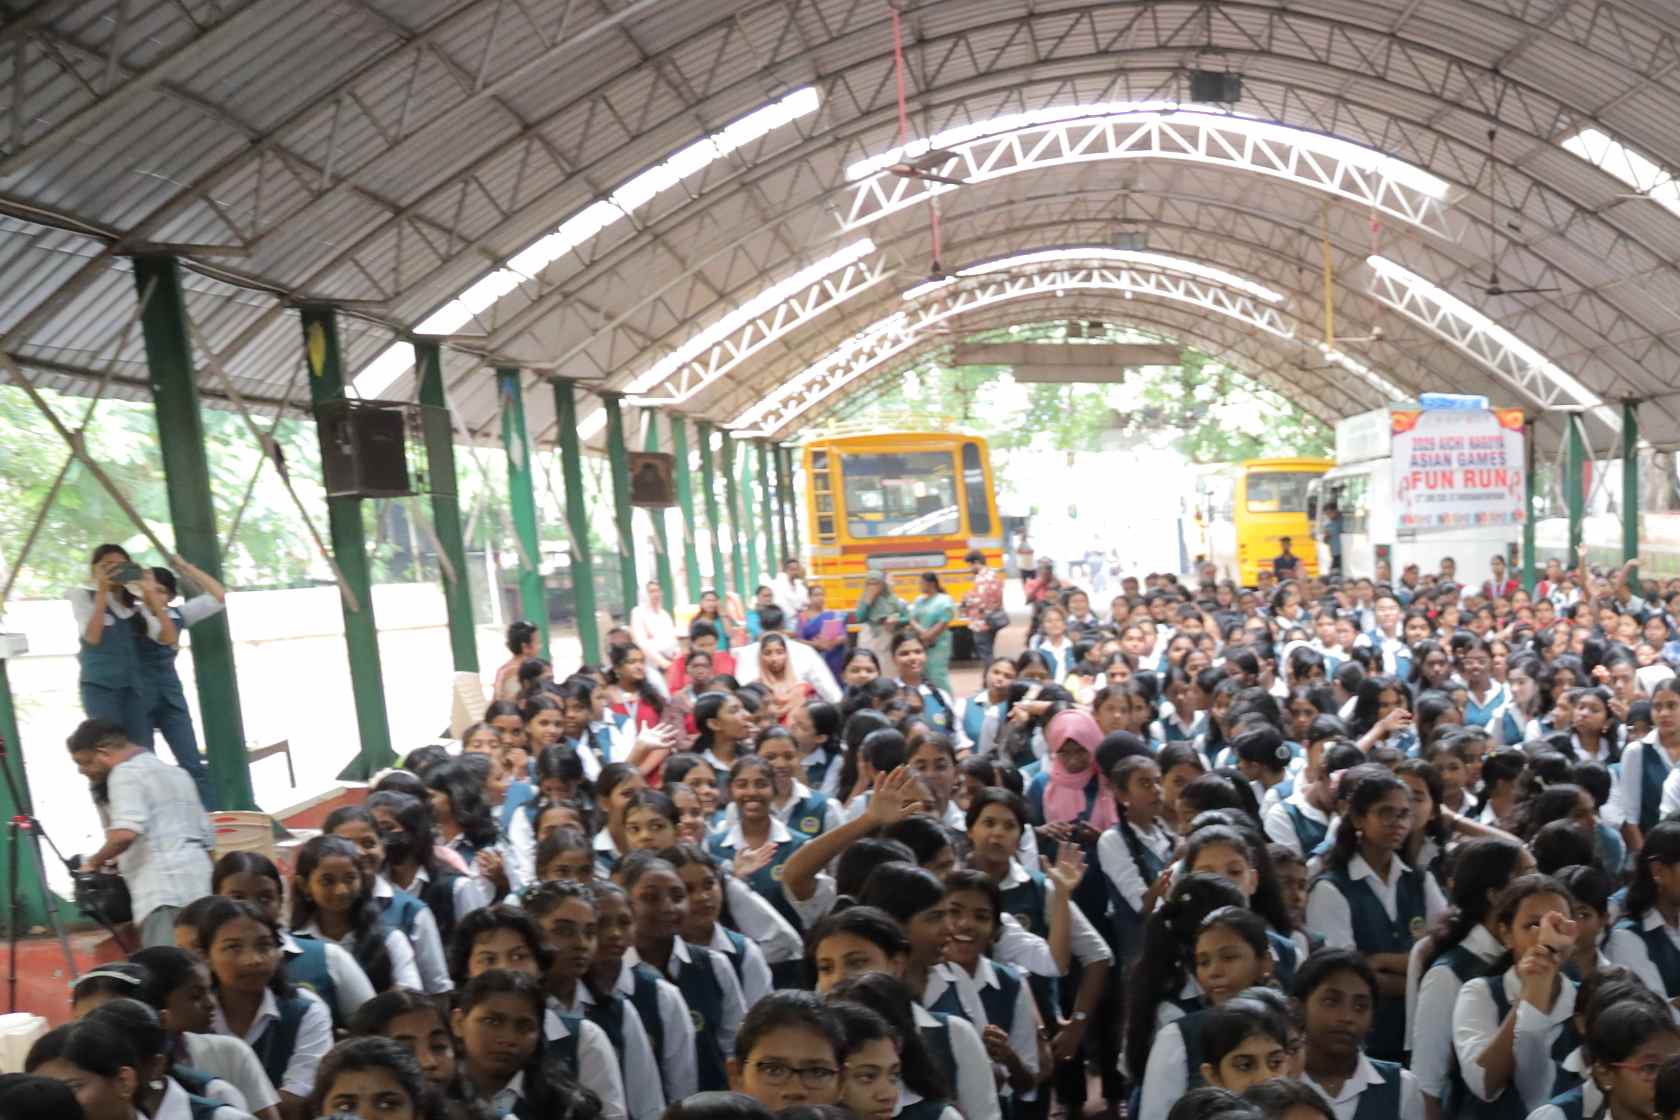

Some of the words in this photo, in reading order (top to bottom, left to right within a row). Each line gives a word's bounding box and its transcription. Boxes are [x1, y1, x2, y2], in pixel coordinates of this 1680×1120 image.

[1411, 453, 1452, 467] ASIAN
[1457, 451, 1505, 465] GAMES
[1410, 470, 1454, 490] FUN
[1464, 468, 1508, 489] RUN
